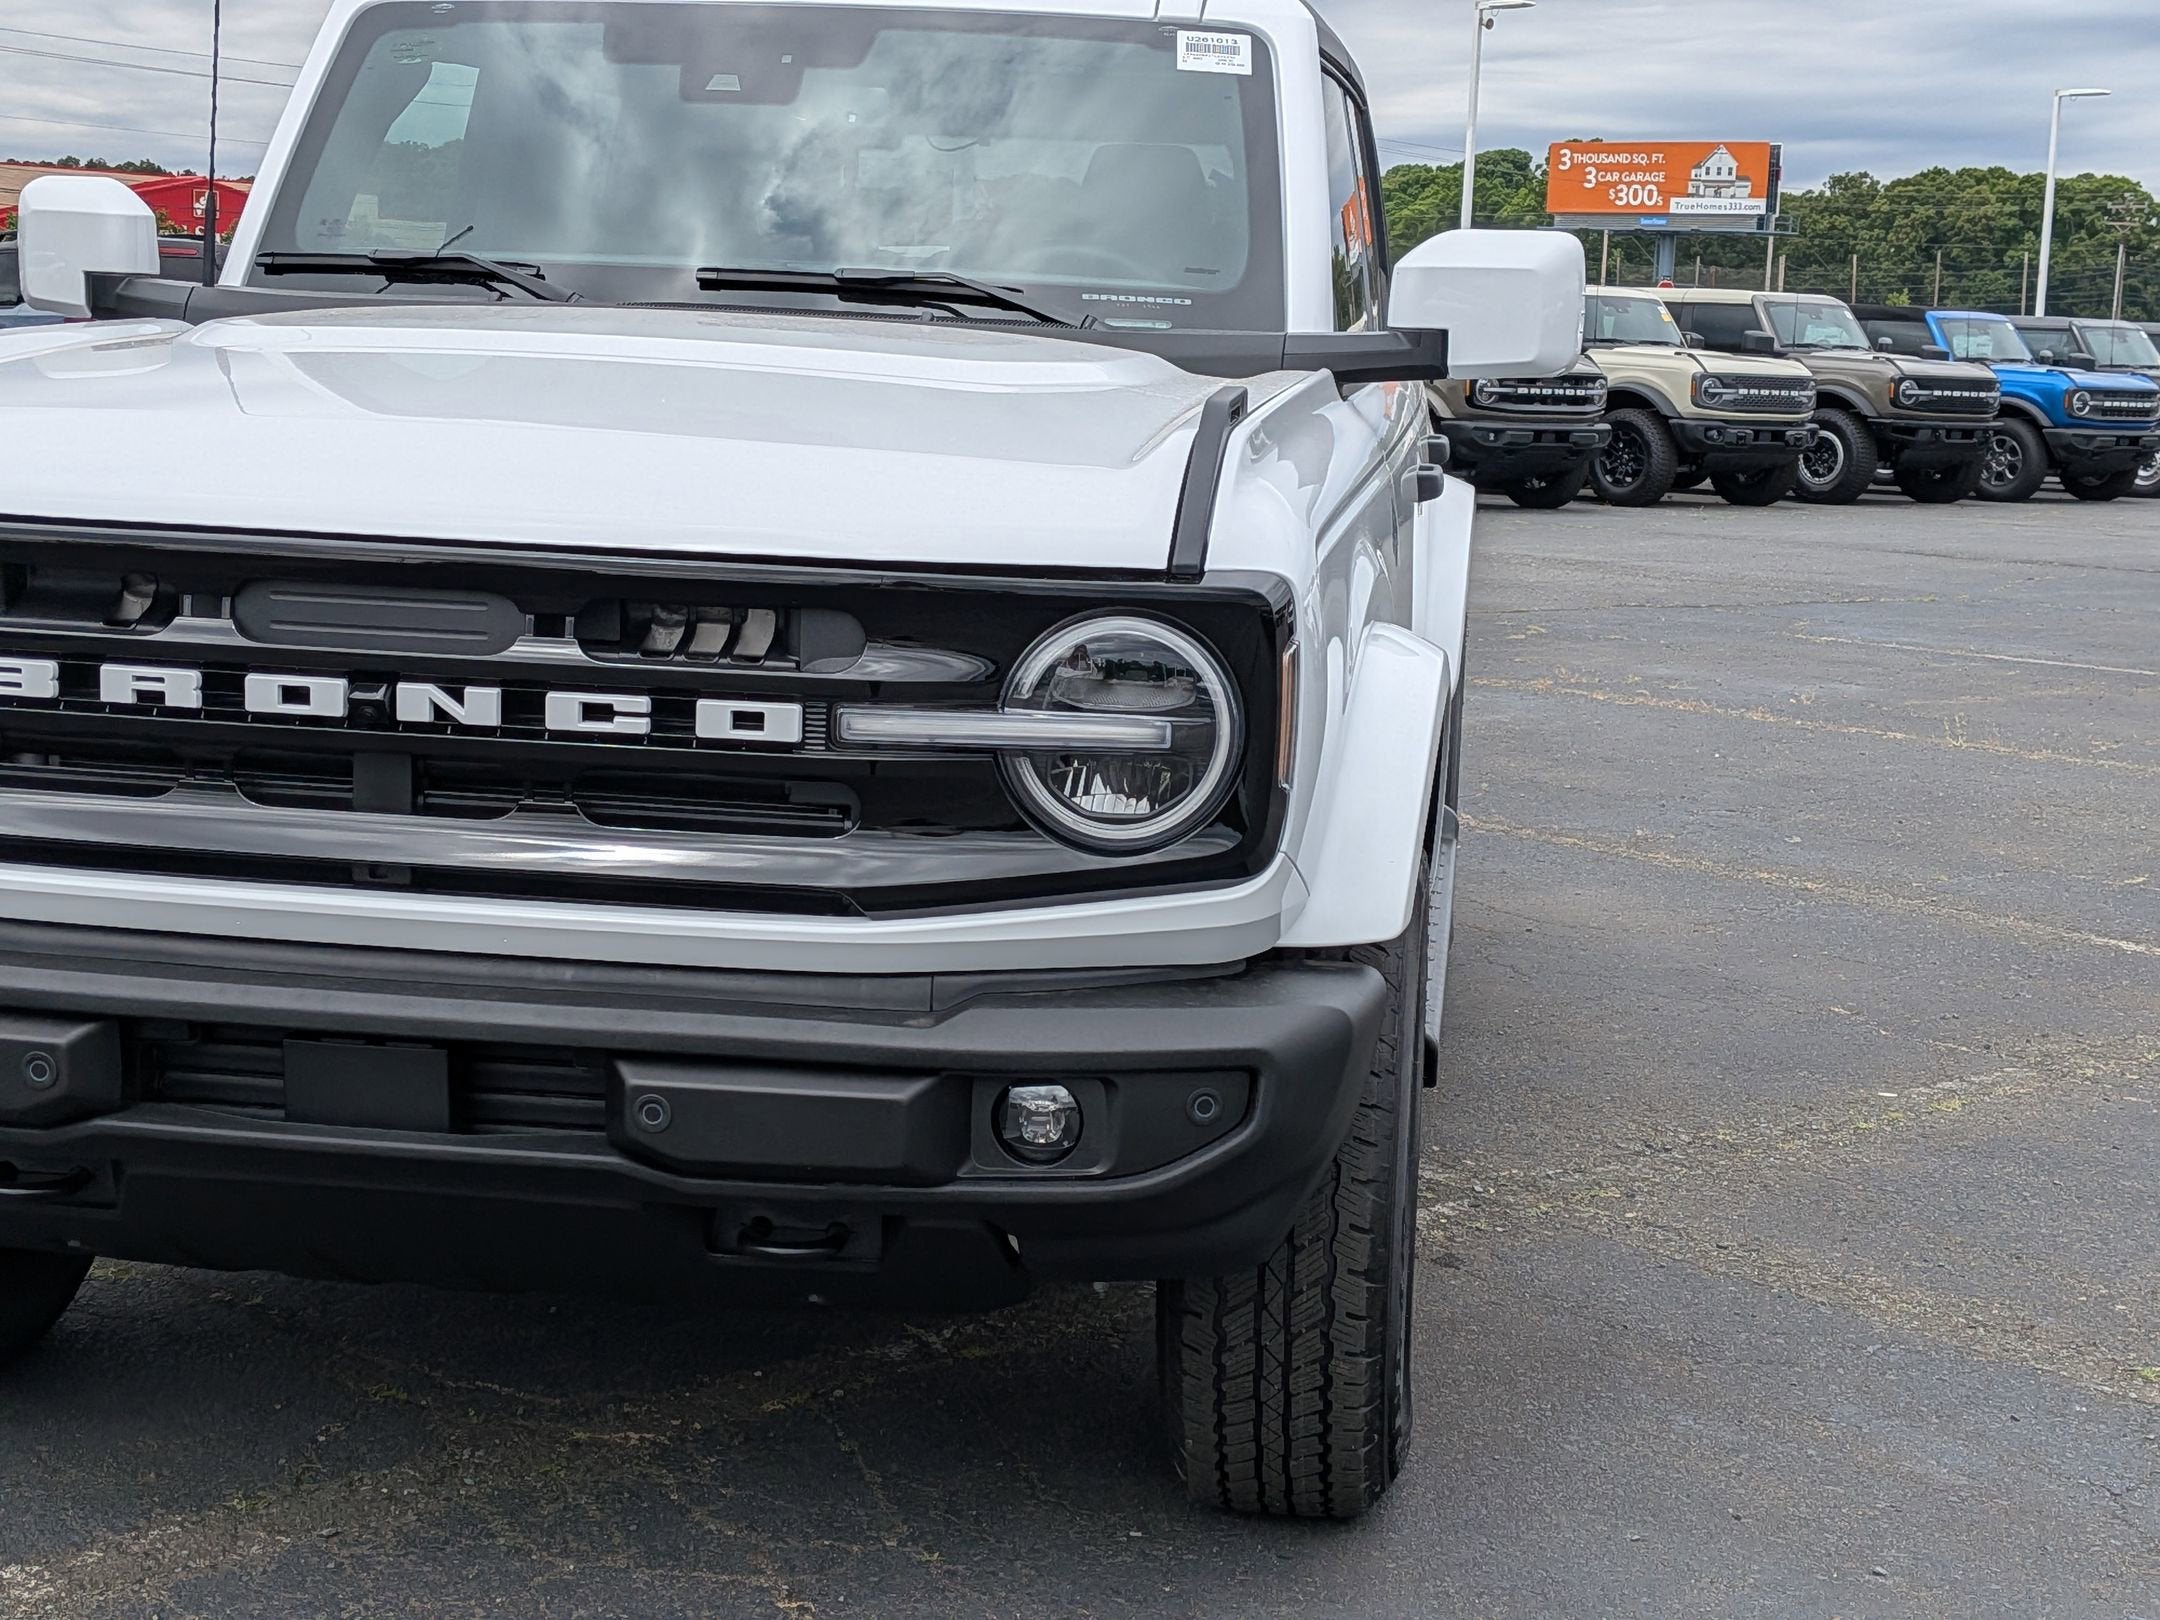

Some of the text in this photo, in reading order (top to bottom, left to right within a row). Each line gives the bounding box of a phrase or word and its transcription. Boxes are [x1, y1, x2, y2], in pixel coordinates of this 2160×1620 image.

[1558, 148, 1666, 170] 3 THOUSAND SQ. FT.
[1583, 166, 1666, 188] 3 CAR GARAGE
[1673, 201, 1762, 212] TrueHomes333.com
[1082, 293, 1192, 305] BRONCO
